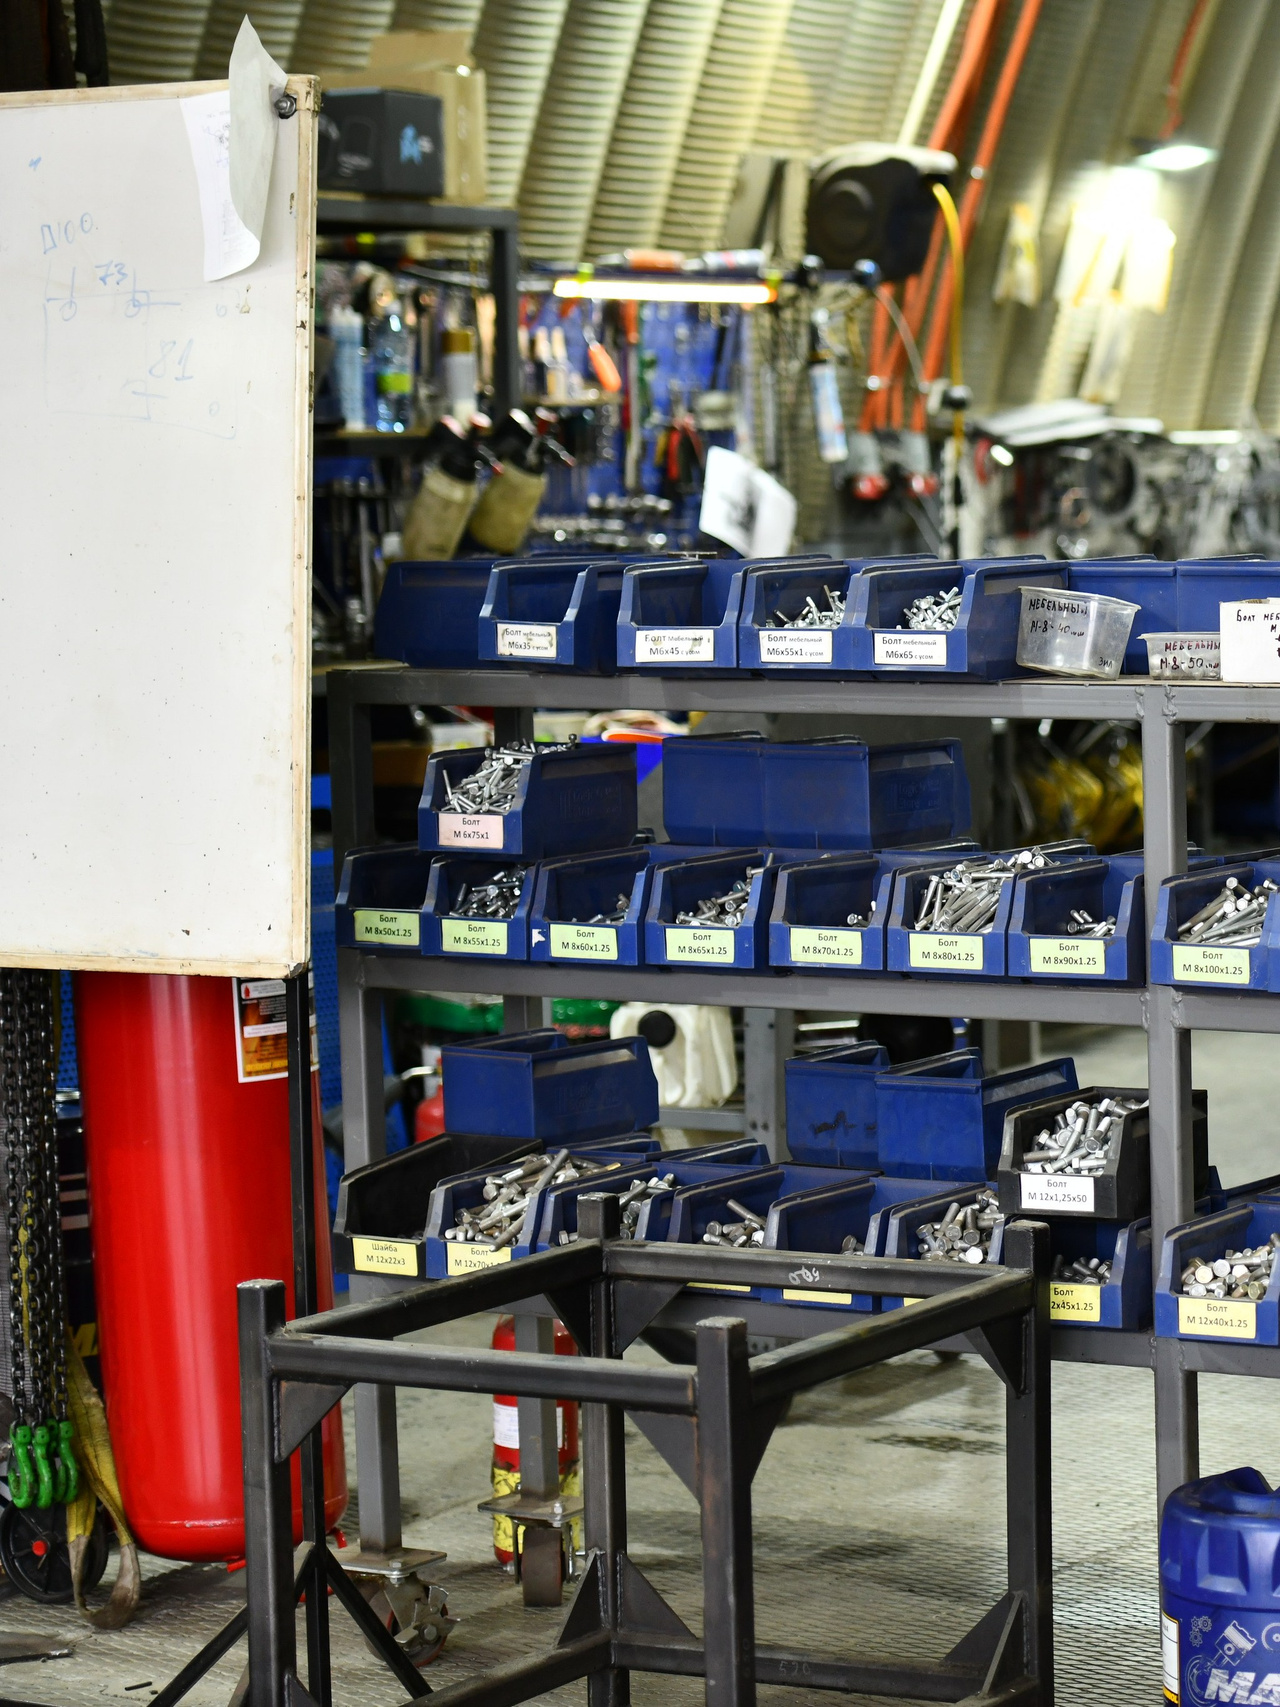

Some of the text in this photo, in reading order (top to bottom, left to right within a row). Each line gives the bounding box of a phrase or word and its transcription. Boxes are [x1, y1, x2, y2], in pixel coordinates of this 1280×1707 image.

[95, 260, 128, 285] 73
[505, 628, 521, 637] Болт
[767, 634, 787, 642] Болт
[882, 636, 902, 645] Болт
[1165, 640, 1220, 652] МЕБЕЛЬНЫ
[766, 647, 804, 656] М6х55х1
[885, 650, 914, 659] М6х65
[462, 818, 481, 826] Болт
[453, 830, 462, 839] М
[379, 914, 398, 923] Болт
[364, 926, 373, 934] М
[467, 924, 486, 933] Болт
[576, 930, 595, 938] Болт
[692, 933, 711, 942] Болт
[818, 933, 838, 942] Болт
[453, 936, 462, 944] М
[938, 939, 958, 947] Болт
[561, 941, 570, 950] М
[677, 945, 686, 954] М
[801, 945, 810, 954] М
[1059, 943, 1080, 952] Болт
[921, 951, 931, 959] М
[1202, 950, 1224, 960] Болт
[1042, 956, 1052, 965] М
[1182, 964, 1192, 973] М
[1047, 1179, 1067, 1188] Болт
[1028, 1192, 1037, 1200] М
[371, 1243, 398, 1253] Шайба
[470, 1247, 489, 1256] Болт
[366, 1254, 374, 1262] М
[454, 1259, 462, 1267] М
[1053, 1287, 1074, 1296] Болт
[1051, 1300, 1094, 1311] 2х45х1.25
[1206, 1304, 1228, 1313] Болт
[1186, 1315, 1196, 1324] М
